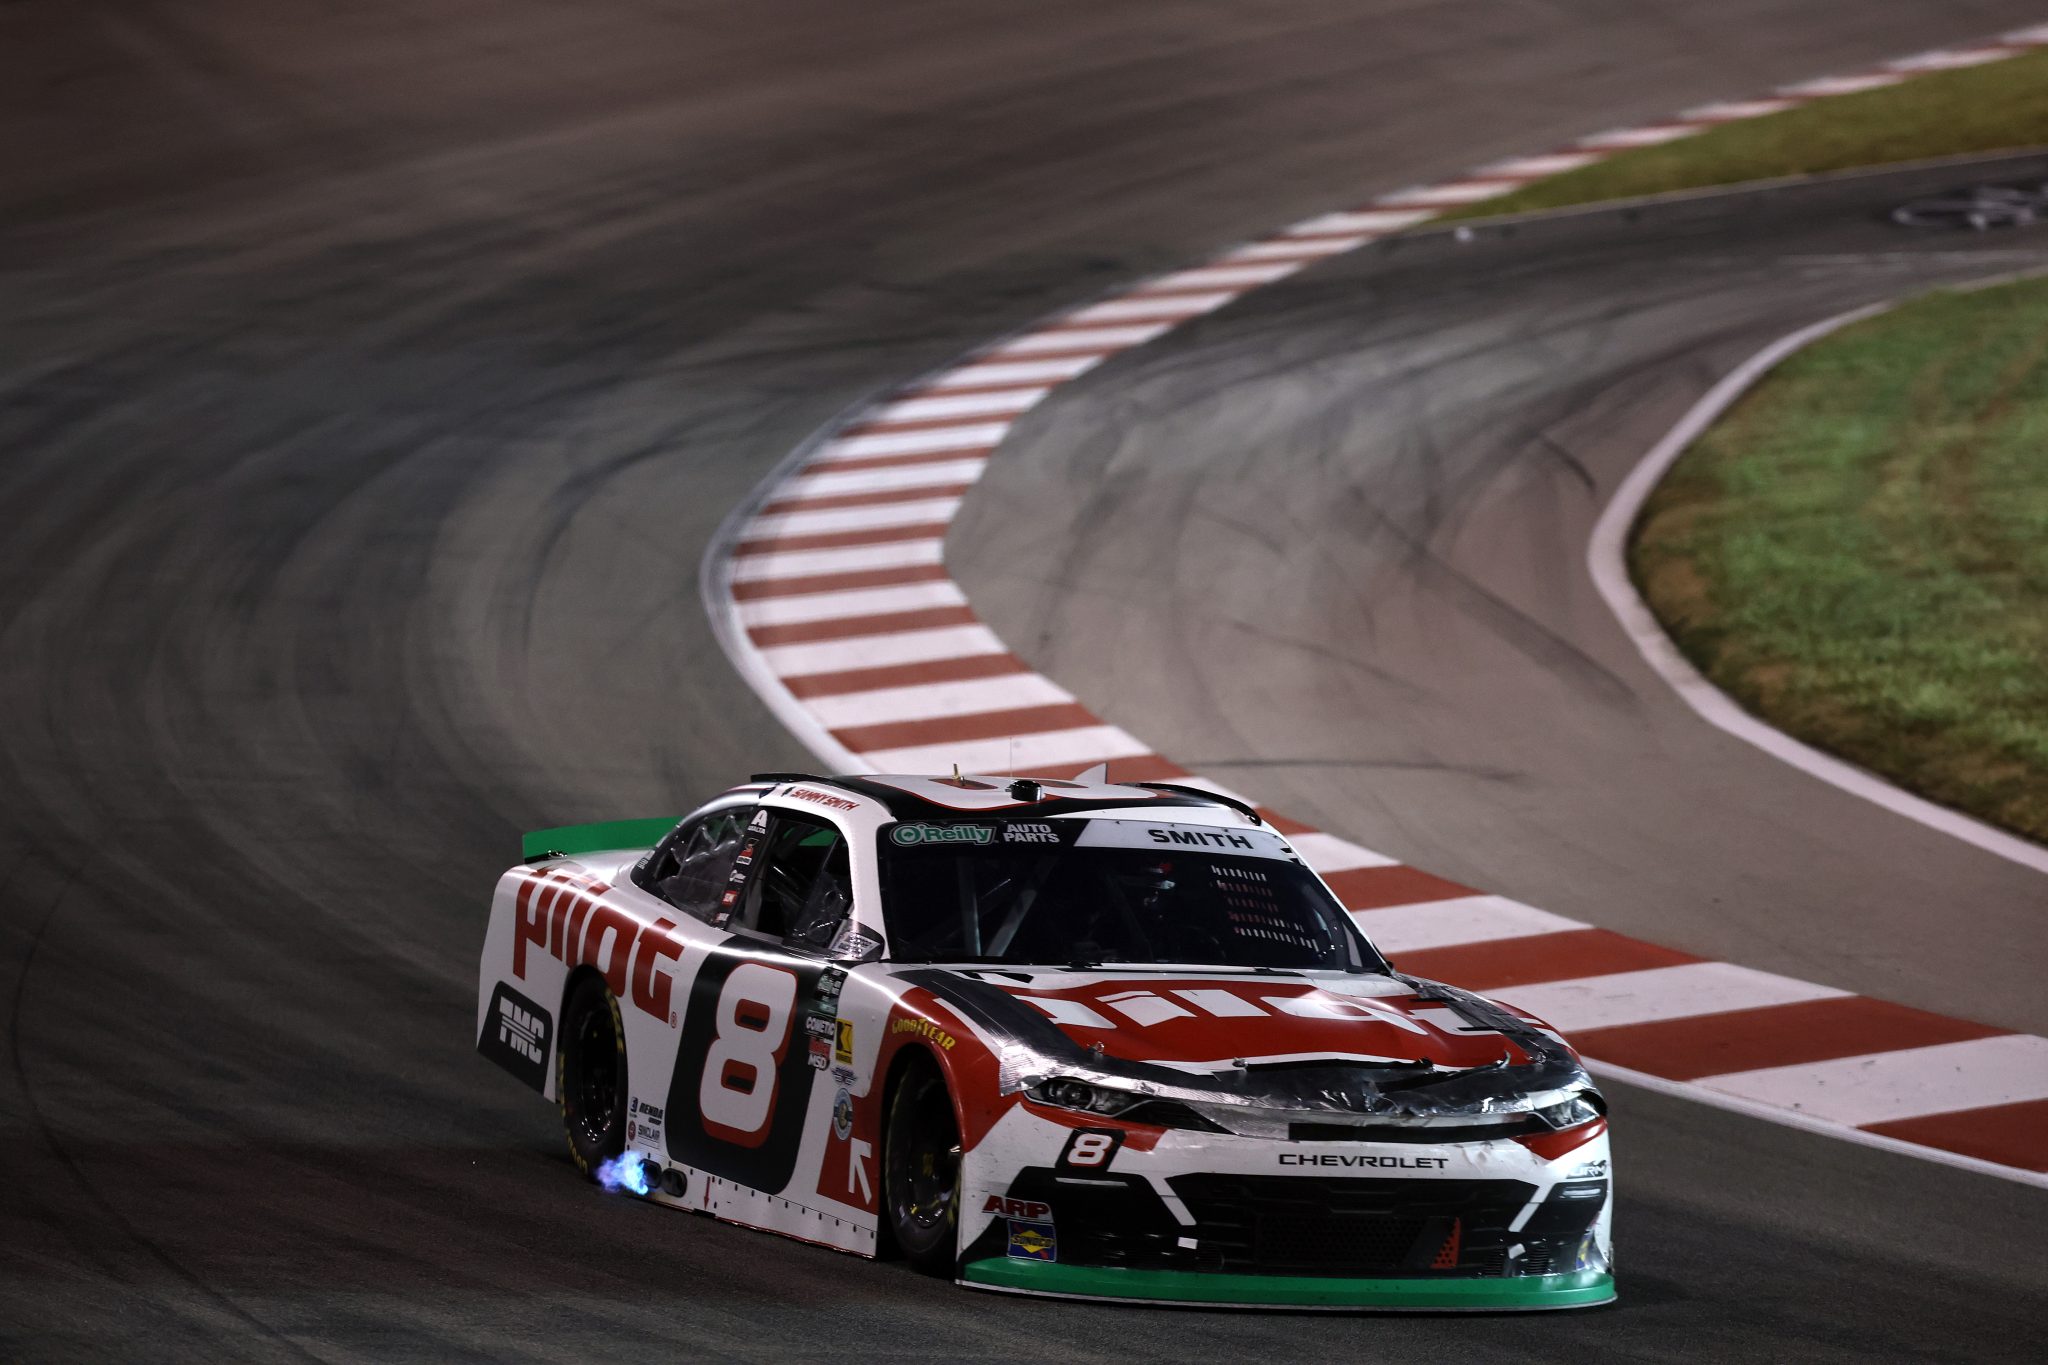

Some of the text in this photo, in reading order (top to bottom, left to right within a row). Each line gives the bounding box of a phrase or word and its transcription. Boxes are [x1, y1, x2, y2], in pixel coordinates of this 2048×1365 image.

[822, 797, 860, 811] SMITH
[891, 823, 994, 845] O'Reilly
[1002, 832, 1061, 843] PARTS
[1006, 823, 1052, 833] AUTO
[1148, 829, 1254, 849] SMITH
[512, 866, 684, 1025] pilot
[500, 996, 546, 1065] TMC
[699, 960, 798, 1148] 8
[808, 1053, 829, 1069] MSD
[1067, 1133, 1115, 1167] 8
[1278, 1154, 1450, 1169] CHEVROLET
[982, 1195, 1049, 1218] ARP
